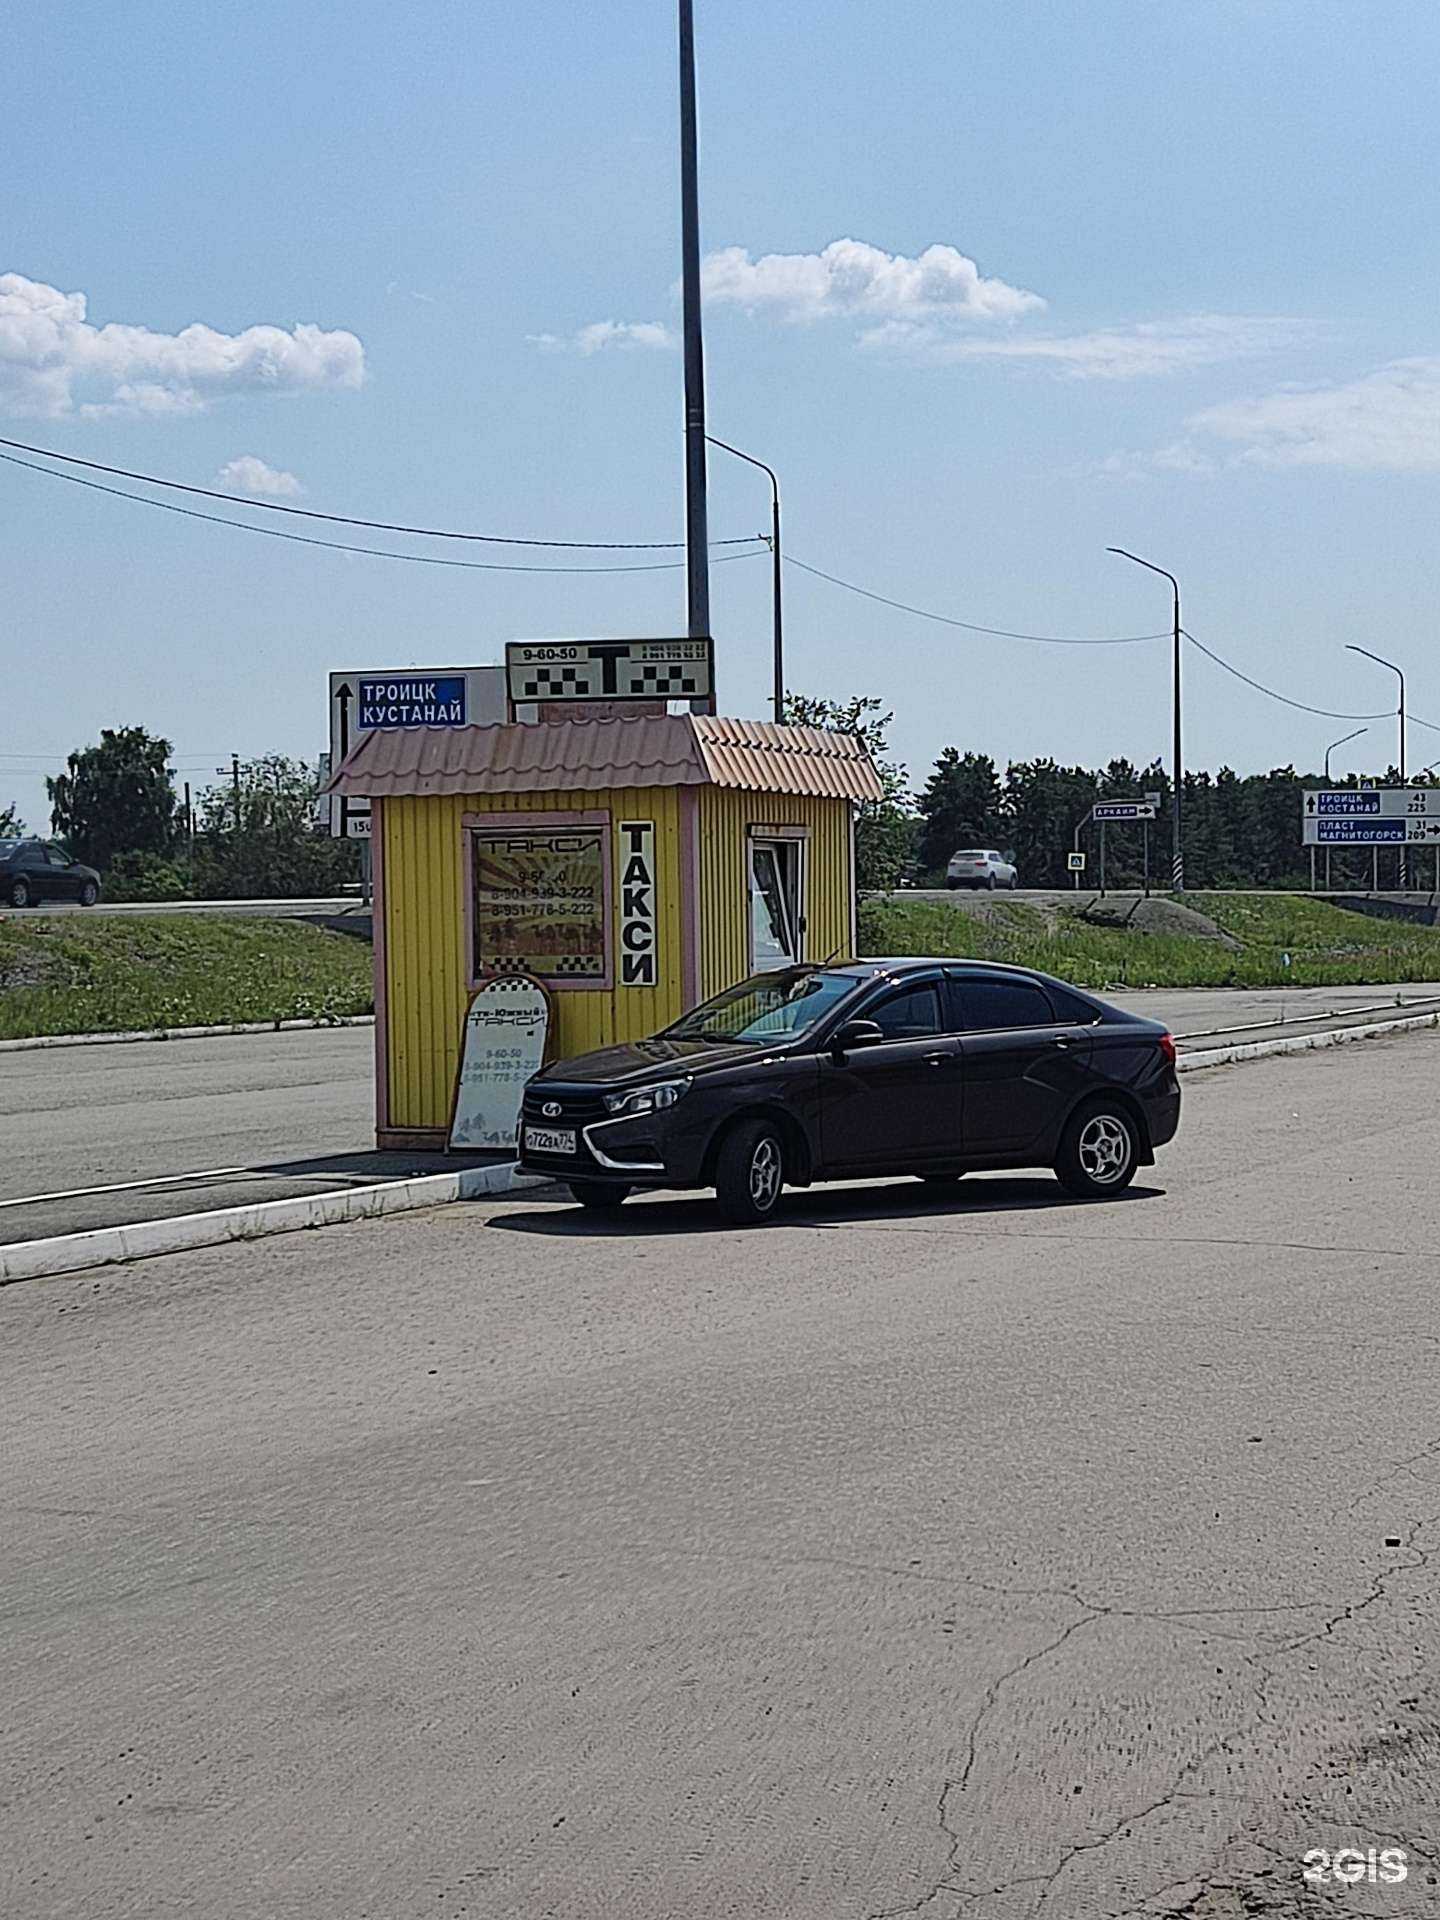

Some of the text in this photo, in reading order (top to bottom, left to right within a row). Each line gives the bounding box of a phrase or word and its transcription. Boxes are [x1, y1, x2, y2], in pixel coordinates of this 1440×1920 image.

[523, 647, 577, 660] 9-60-50
[363, 683, 437, 703] ТРОИЦК
[363, 700, 461, 723] КУСТАНАЙ
[1320, 794, 1363, 804] ТРОИЦК
[1097, 808, 1136, 816] АРКАИМ
[1320, 802, 1426, 813] КОСТАНАЙ 225
[1320, 822, 1355, 830] ПЛАСТ
[1320, 830, 1426, 840] МАГНИТОГОРСК 209
[480, 838, 603, 855] ТАКСИ
[621, 823, 653, 983] ТАКСИ
[470, 1016, 546, 1027] ТАКСИ
